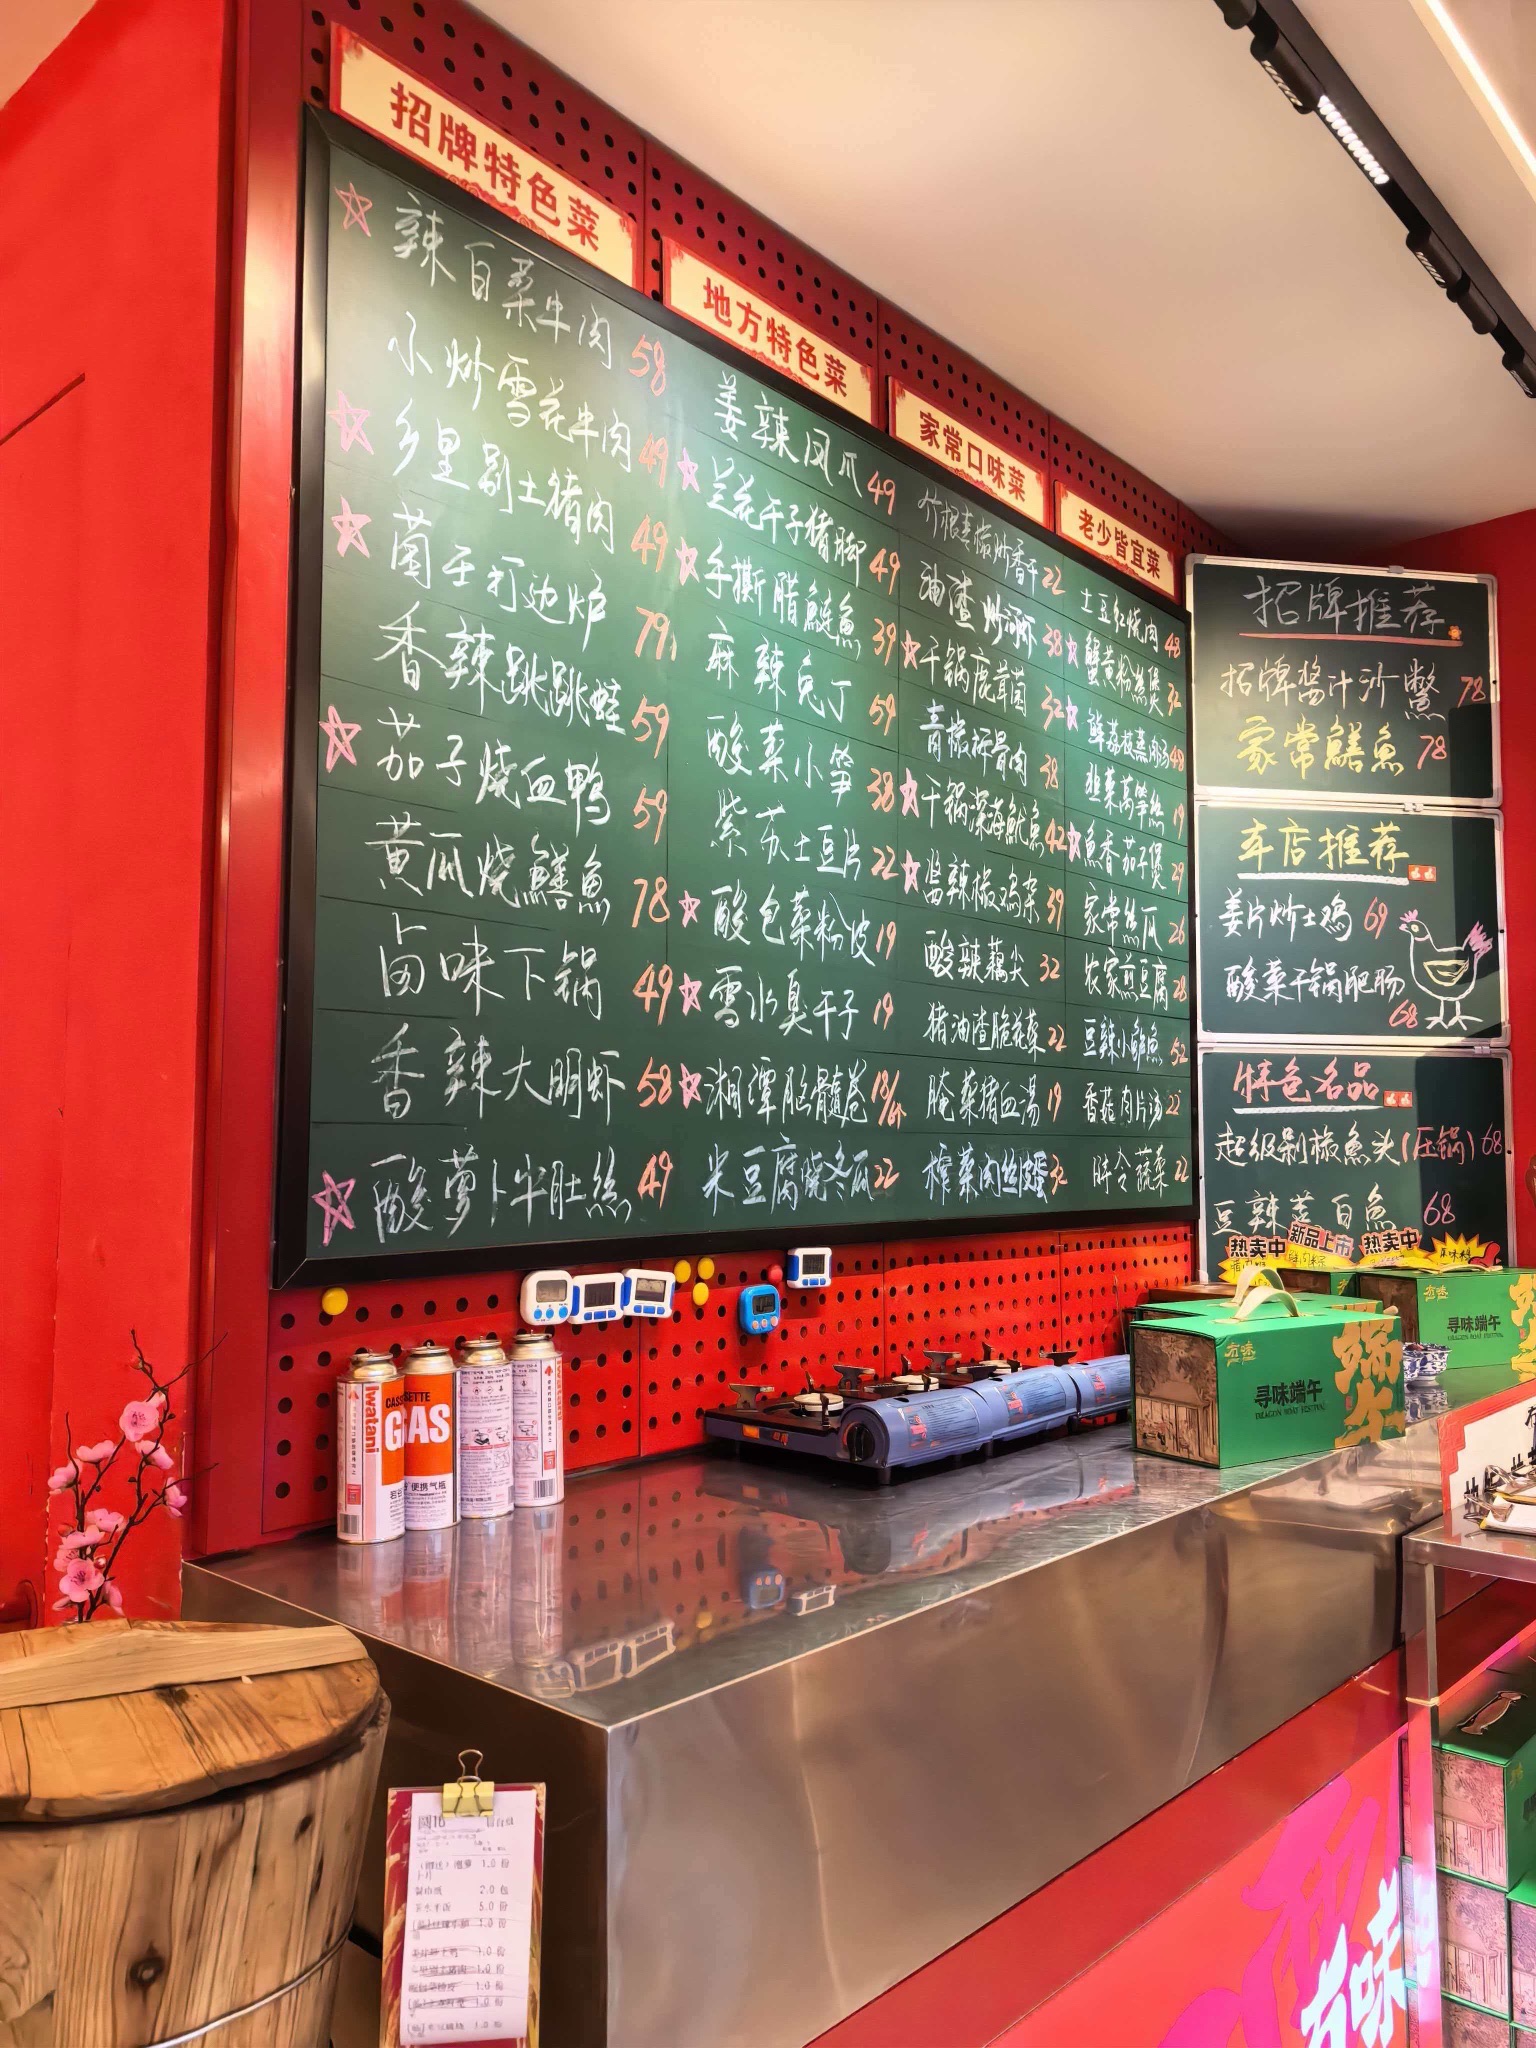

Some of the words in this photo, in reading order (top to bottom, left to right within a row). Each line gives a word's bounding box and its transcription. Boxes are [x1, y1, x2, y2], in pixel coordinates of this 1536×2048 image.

[390, 81, 600, 252] 招牌特色菜
[703, 277, 848, 397] 地方特色菜
[628, 335, 667, 396] 58
[388, 311, 632, 473] 小炒雪花牛肉
[638, 434, 669, 489] 49
[714, 370, 863, 498] 姜辣凤爪
[867, 470, 896, 515] 49
[919, 410, 1026, 502] 家常口味菜
[631, 515, 669, 573] 49
[1078, 508, 1161, 580] 老少皆宜菜
[391, 495, 607, 652] 菌王打边炉
[634, 606, 671, 660] 79
[869, 548, 901, 595] 49
[1042, 565, 1066, 596] 22
[1081, 588, 1159, 653] 土豆红烧肉
[1164, 632, 1181, 660] 48
[1243, 575, 1446, 635] 招牌推荐
[872, 617, 897, 666] 39
[373, 601, 626, 735] 香辣跳跳蛙
[632, 694, 670, 759] 59
[705, 615, 852, 723] 麻辣兔丁
[869, 693, 896, 736] 59
[1457, 675, 1487, 709] 78
[376, 707, 611, 837] 茄子烧血鸭
[632, 787, 668, 845] 59
[1416, 735, 1447, 770] 78
[866, 767, 895, 813] 38
[1044, 817, 1068, 855] 42
[1173, 802, 1185, 840] 19
[870, 845, 899, 880] 22
[1171, 861, 1185, 895] 29
[632, 876, 670, 929] 78
[711, 878, 876, 967] 酸包菜粉皮
[876, 921, 896, 960] 19
[1046, 884, 1065, 932] 39
[1363, 896, 1388, 940] 69
[1168, 915, 1185, 946] 26
[924, 928, 1030, 987] 酸辣藕尖
[1040, 953, 1060, 982] 32
[1085, 947, 1168, 1012] 农家煎豆腐
[1172, 976, 1188, 1003] 28
[632, 963, 673, 1026] 49
[873, 992, 894, 1031] 19
[1223, 955, 1406, 1004] 酸菜干锅肥肠
[1389, 1000, 1418, 1028] 68
[1048, 1024, 1067, 1051] 22
[1170, 1036, 1189, 1066] 52
[371, 1023, 625, 1126] 香辣大明虾
[637, 1056, 672, 1108] 58
[1233, 1055, 1380, 1104] 特色名品
[1047, 1081, 1062, 1123] 19
[1082, 1082, 1163, 1131] 香菇肉片汤
[1166, 1092, 1182, 1115] 22
[1481, 1123, 1503, 1156] 68
[638, 1151, 673, 1210] 49
[874, 1157, 900, 1190] 22
[1174, 1154, 1189, 1183] 22
[1423, 1191, 1456, 1227] 68
[1230, 1238, 1286, 1258] 热卖中
[1290, 1223, 1351, 1257] 新品上市
[1364, 1230, 1417, 1254] 热卖中
[1447, 1314, 1501, 1333] 寻味端午
[1254, 1379, 1323, 1408] 寻味端午
[365, 1386, 379, 1454] Iwatani
